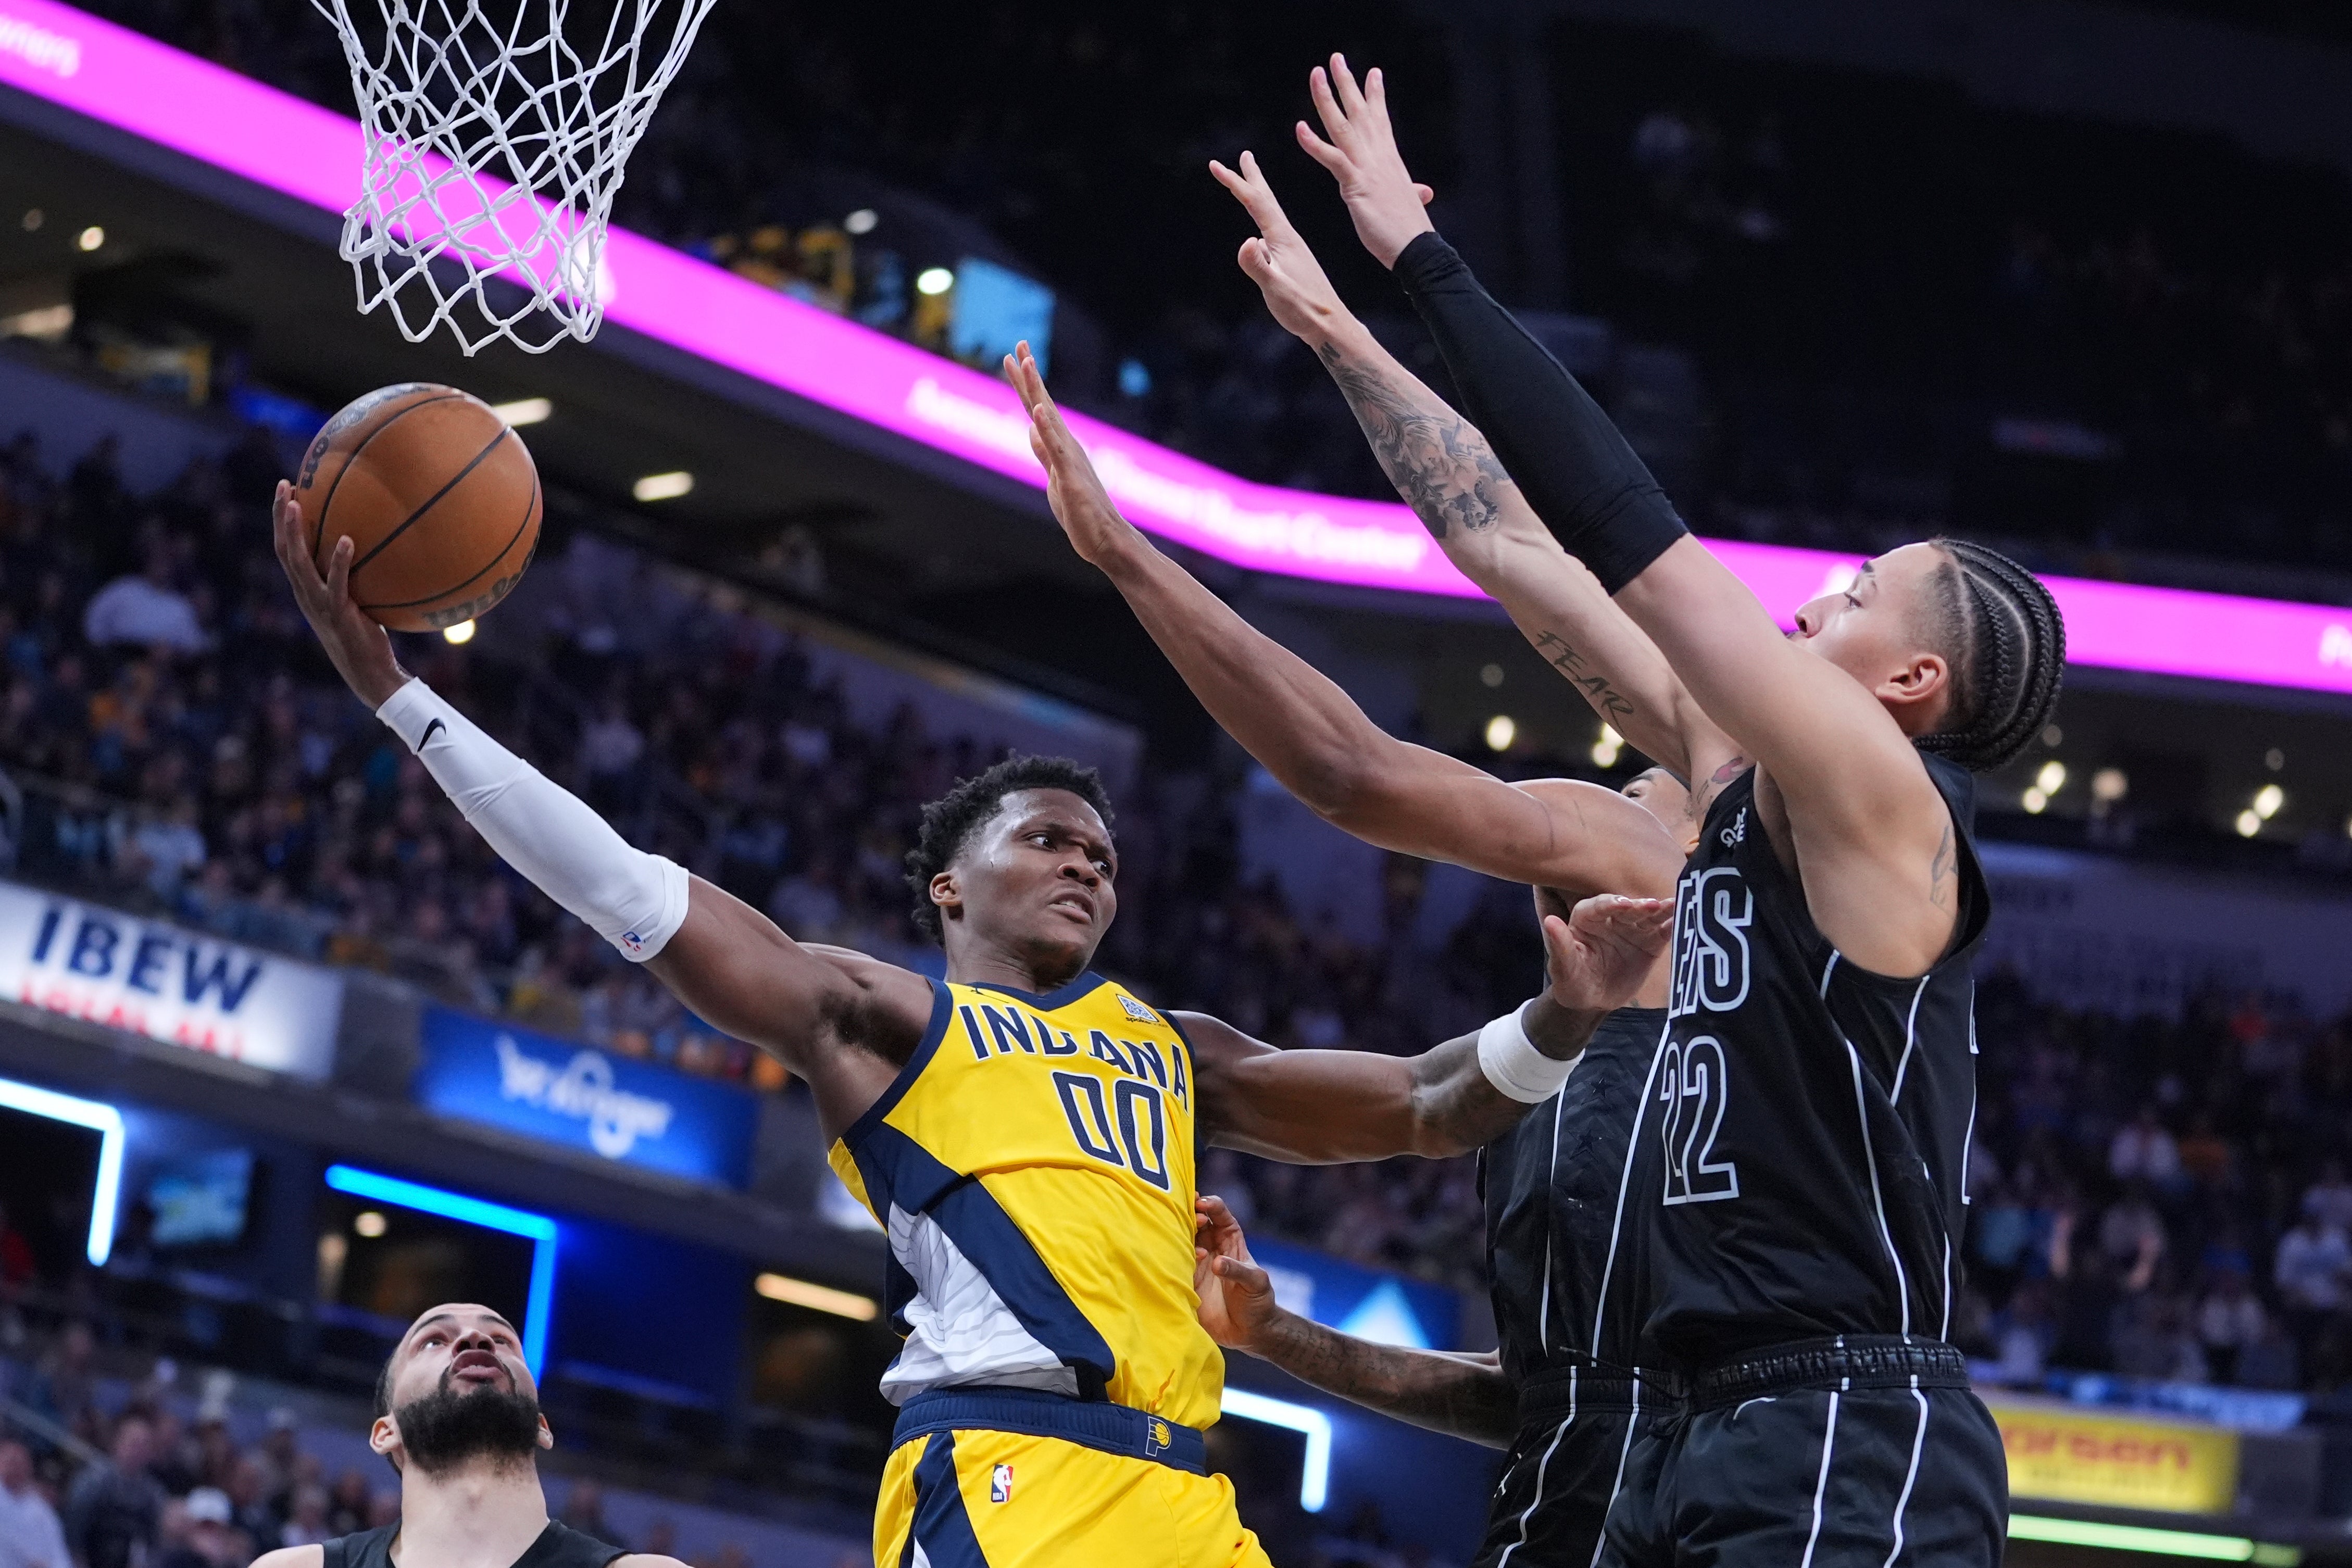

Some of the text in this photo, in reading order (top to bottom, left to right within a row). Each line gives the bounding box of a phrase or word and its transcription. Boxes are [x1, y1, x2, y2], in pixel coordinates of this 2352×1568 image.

[1536, 630, 1634, 735] FEAR
[32, 909, 261, 1013] IBEW
[1667, 867, 1754, 1019] ETS
[957, 1003, 1190, 1117] INDANA
[1050, 1070, 1172, 1194] 00
[1660, 1035, 1740, 1206] 22
[992, 1492, 1003, 1501] NBA
